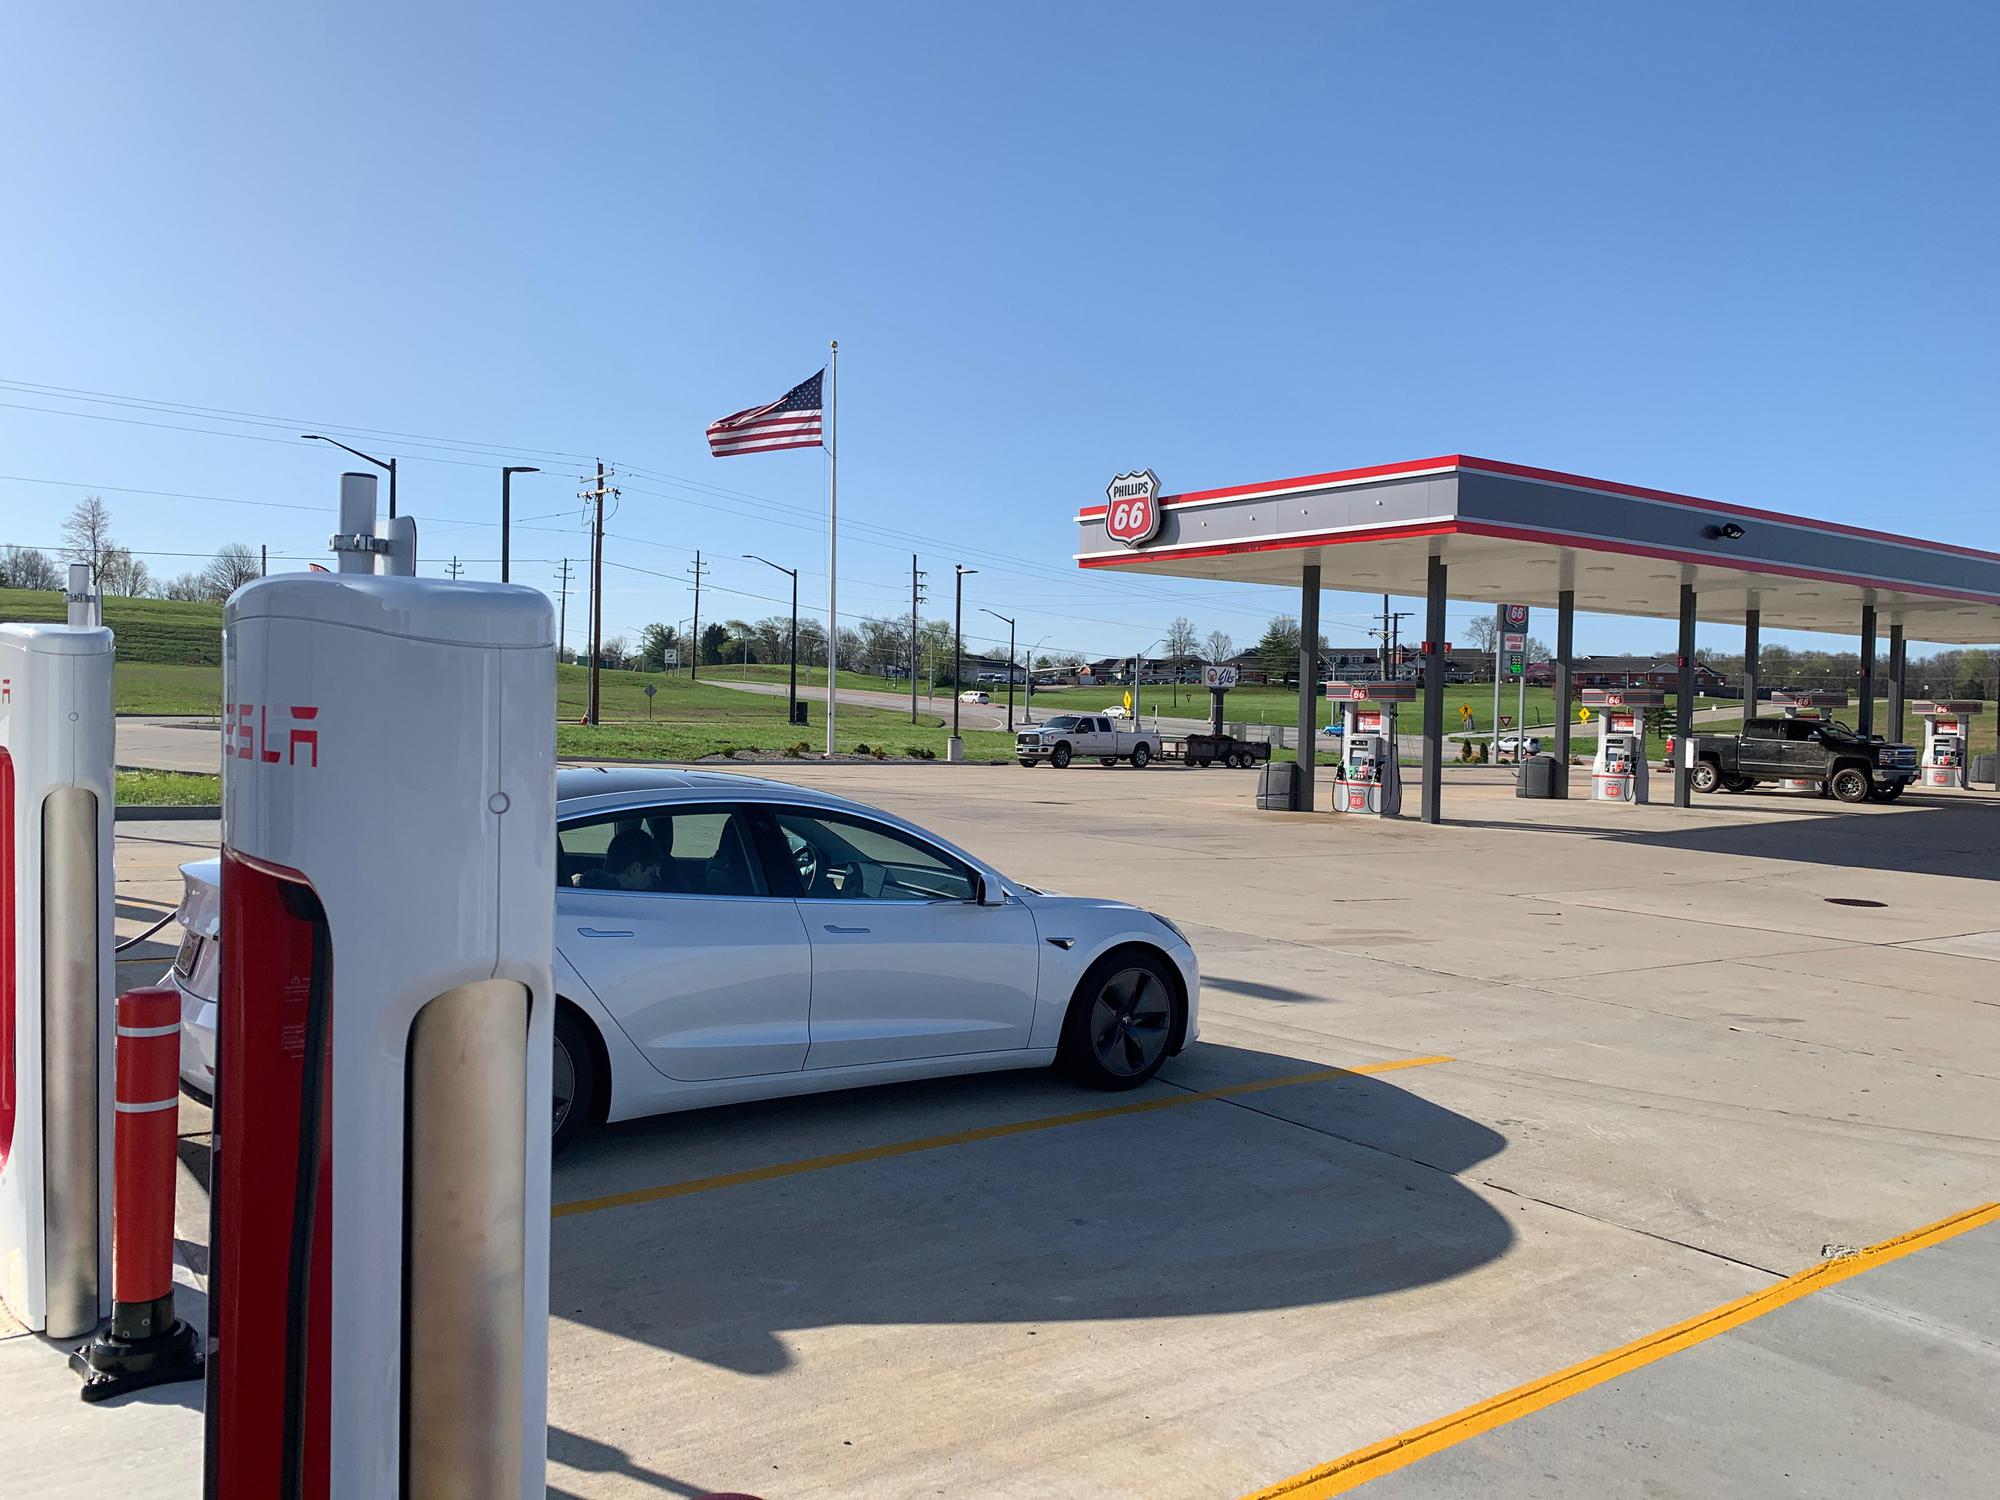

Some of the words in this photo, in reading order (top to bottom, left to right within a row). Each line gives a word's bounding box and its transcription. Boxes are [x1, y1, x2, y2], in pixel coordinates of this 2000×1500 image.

[1113, 481, 1149, 498] PHILLIPS
[1114, 502, 1145, 530] 66
[1511, 607, 1524, 619] 66
[1217, 668, 1235, 686] Elks
[1353, 689, 1365, 699] 66
[1608, 696, 1620, 704] 66
[1797, 698, 1809, 706] 66
[225, 703, 319, 768] ESLA
